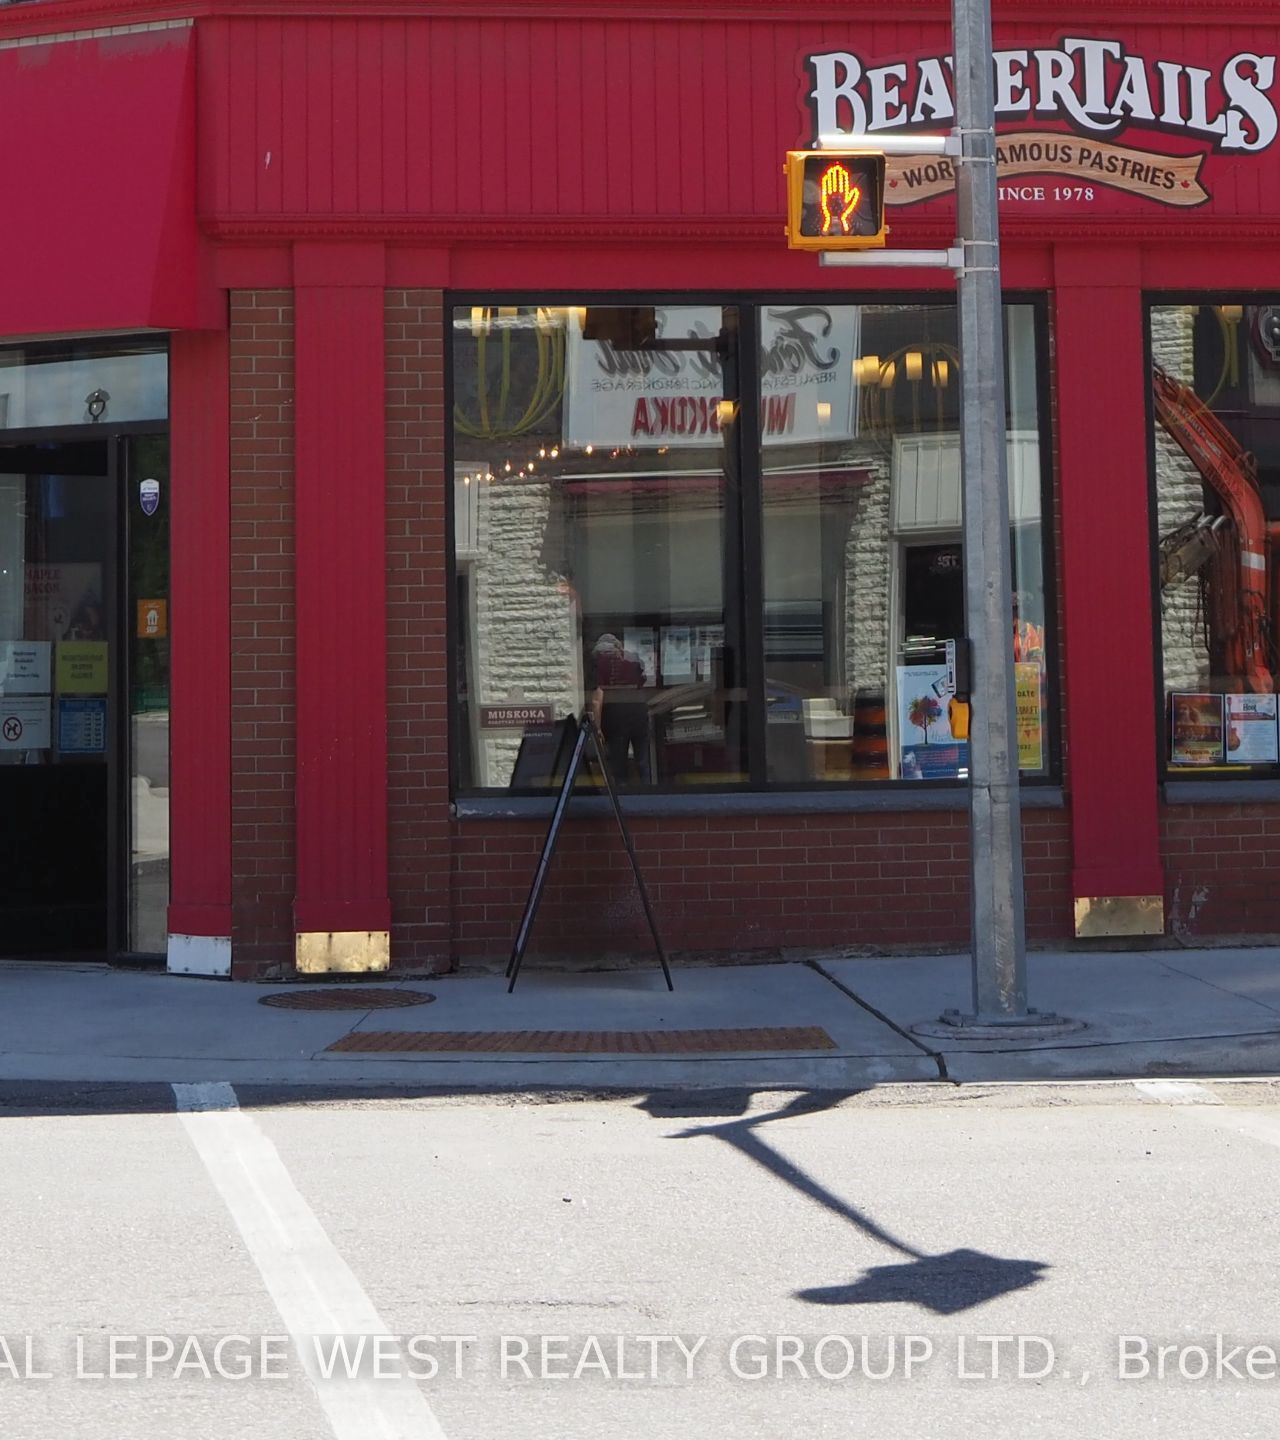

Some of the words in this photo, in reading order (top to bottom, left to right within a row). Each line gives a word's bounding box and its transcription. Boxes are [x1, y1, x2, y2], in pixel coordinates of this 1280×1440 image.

[808, 38, 1278, 151] BEAERTAILS
[902, 160, 955, 189] WOR
[996, 143, 1072, 165] AMOUS
[1077, 152, 1175, 190] PASTRIES
[998, 187, 1046, 201] INCE
[1052, 187, 1094, 201] 1978
[488, 710, 545, 719] MUSKOKA
